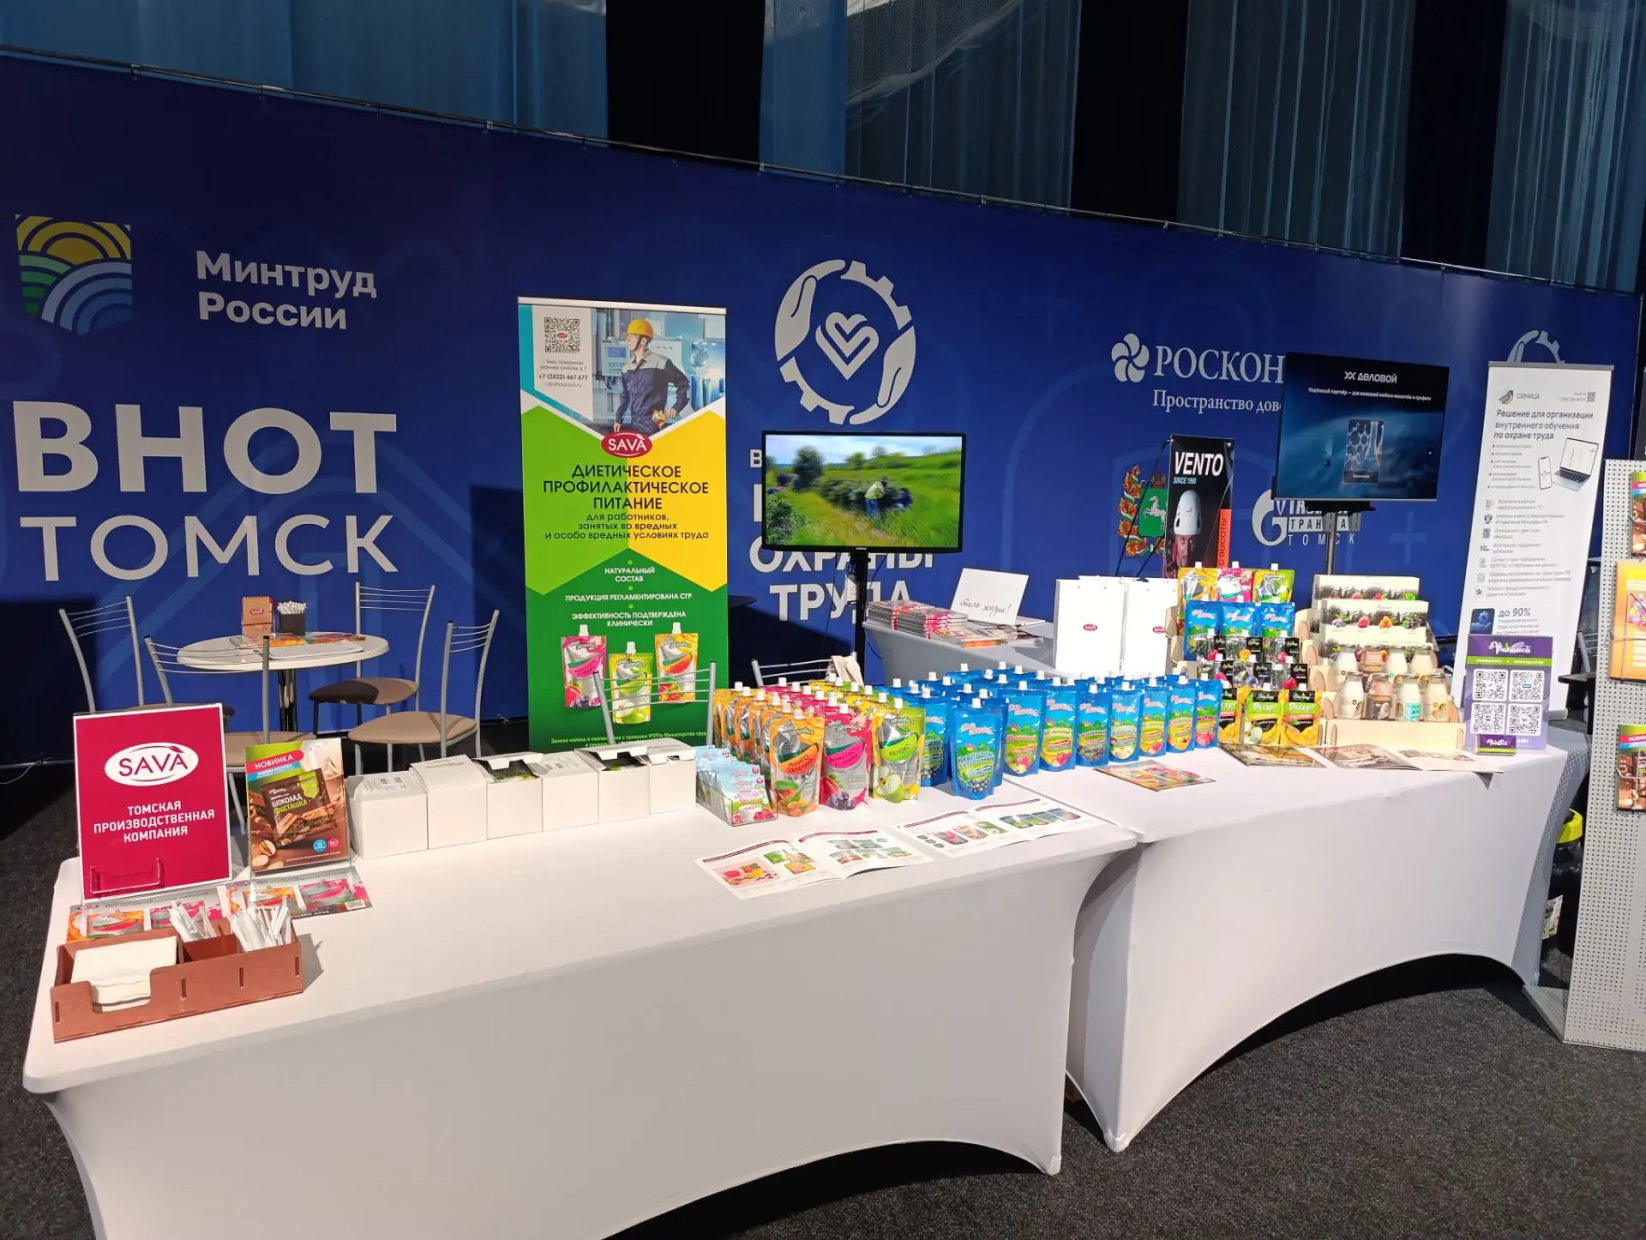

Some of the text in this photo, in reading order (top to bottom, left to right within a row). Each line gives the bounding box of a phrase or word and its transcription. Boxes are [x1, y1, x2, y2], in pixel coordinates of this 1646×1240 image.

[196, 251, 377, 298] Минтруд
[199, 291, 347, 330] России
[1154, 345, 1286, 384] РОСКОН
[1153, 389, 1282, 414] Пространство дов
[1496, 409, 1594, 419] Решение для организации
[1495, 422, 1580, 430] внутреннего обучения
[1532, 433, 1554, 441] труда
[13, 401, 397, 495] ВНОТ
[608, 438, 647, 452] SAVA
[1175, 451, 1224, 476] VENTO
[571, 464, 681, 479] ДИЕТИЧЕСКОЕ
[543, 480, 709, 494] ПРОФИЛАКТИЧЕСКОЕ
[593, 497, 662, 510] ПИТАНИЕ
[586, 513, 669, 522] для работников,
[578, 522, 618, 530] занятых
[635, 522, 677, 531] вредных
[554, 530, 586, 539] особо
[588, 531, 630, 540] вредных
[634, 531, 678, 540] условиях
[680, 531, 709, 540] труда
[20, 514, 399, 582] ТОМСК
[604, 566, 655, 574] НАТУРАЛЬНЫЙ
[565, 592, 692, 602] ПРОДУКЦИЯ РЕГЛАМЕНТИРОВАНА СГР
[572, 611, 686, 620] ЭФФЕКТИВНОСТЬ ПОДТВЕРЖДЕНА
[1498, 607, 1531, 618] до 90%
[607, 619, 653, 627] КЛИНИЧЕСКИ
[118, 753, 189, 777] SAVA
[254, 754, 294, 769] НОВИНКА
[127, 800, 181, 816] ТОМСКАЯ
[93, 809, 215, 834] ПРОИЗВОДСТВЕННАЯ
[123, 825, 188, 843] КОМПАНИЯ
